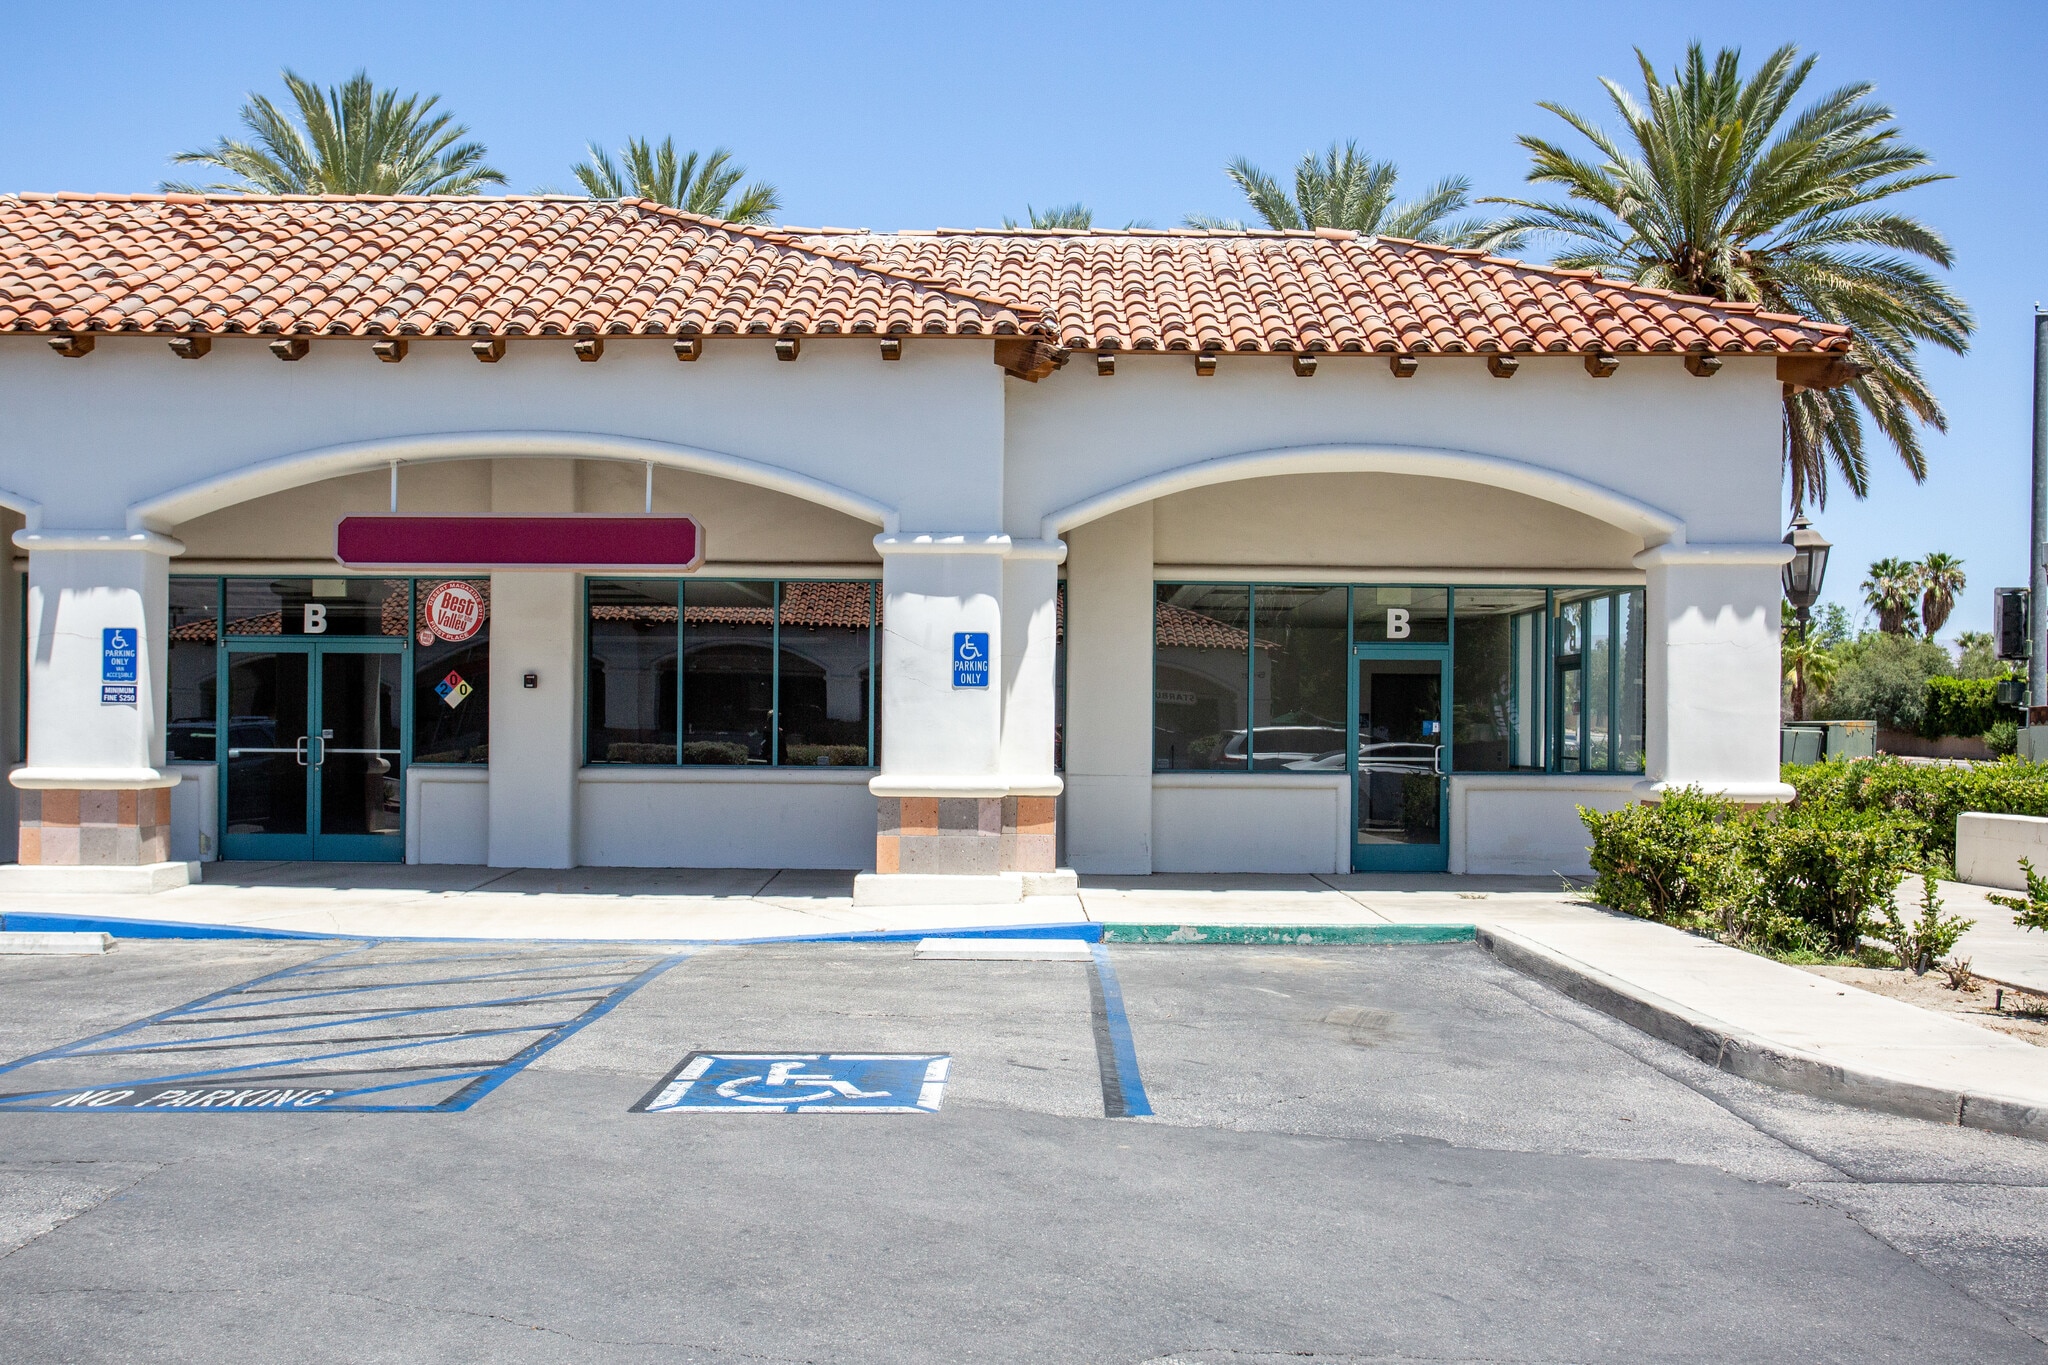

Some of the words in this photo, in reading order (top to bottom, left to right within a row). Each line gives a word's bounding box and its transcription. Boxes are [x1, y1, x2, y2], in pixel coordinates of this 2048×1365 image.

[428, 585, 448, 606] DESERT
[449, 582, 481, 603] MAGAZINE
[441, 592, 475, 616] Best
[303, 603, 328, 634] B
[437, 609, 468, 632] Valley
[1386, 608, 1411, 639] B
[429, 620, 446, 638] FIRST
[446, 631, 470, 640] PLACE
[954, 661, 988, 671] PARKING
[450, 674, 458, 686] 0
[961, 673, 981, 684] ONLY
[440, 683, 449, 695] 2
[459, 683, 468, 696] 0
[51, 1089, 135, 1107] NO
[135, 1088, 335, 1107] PARKING
